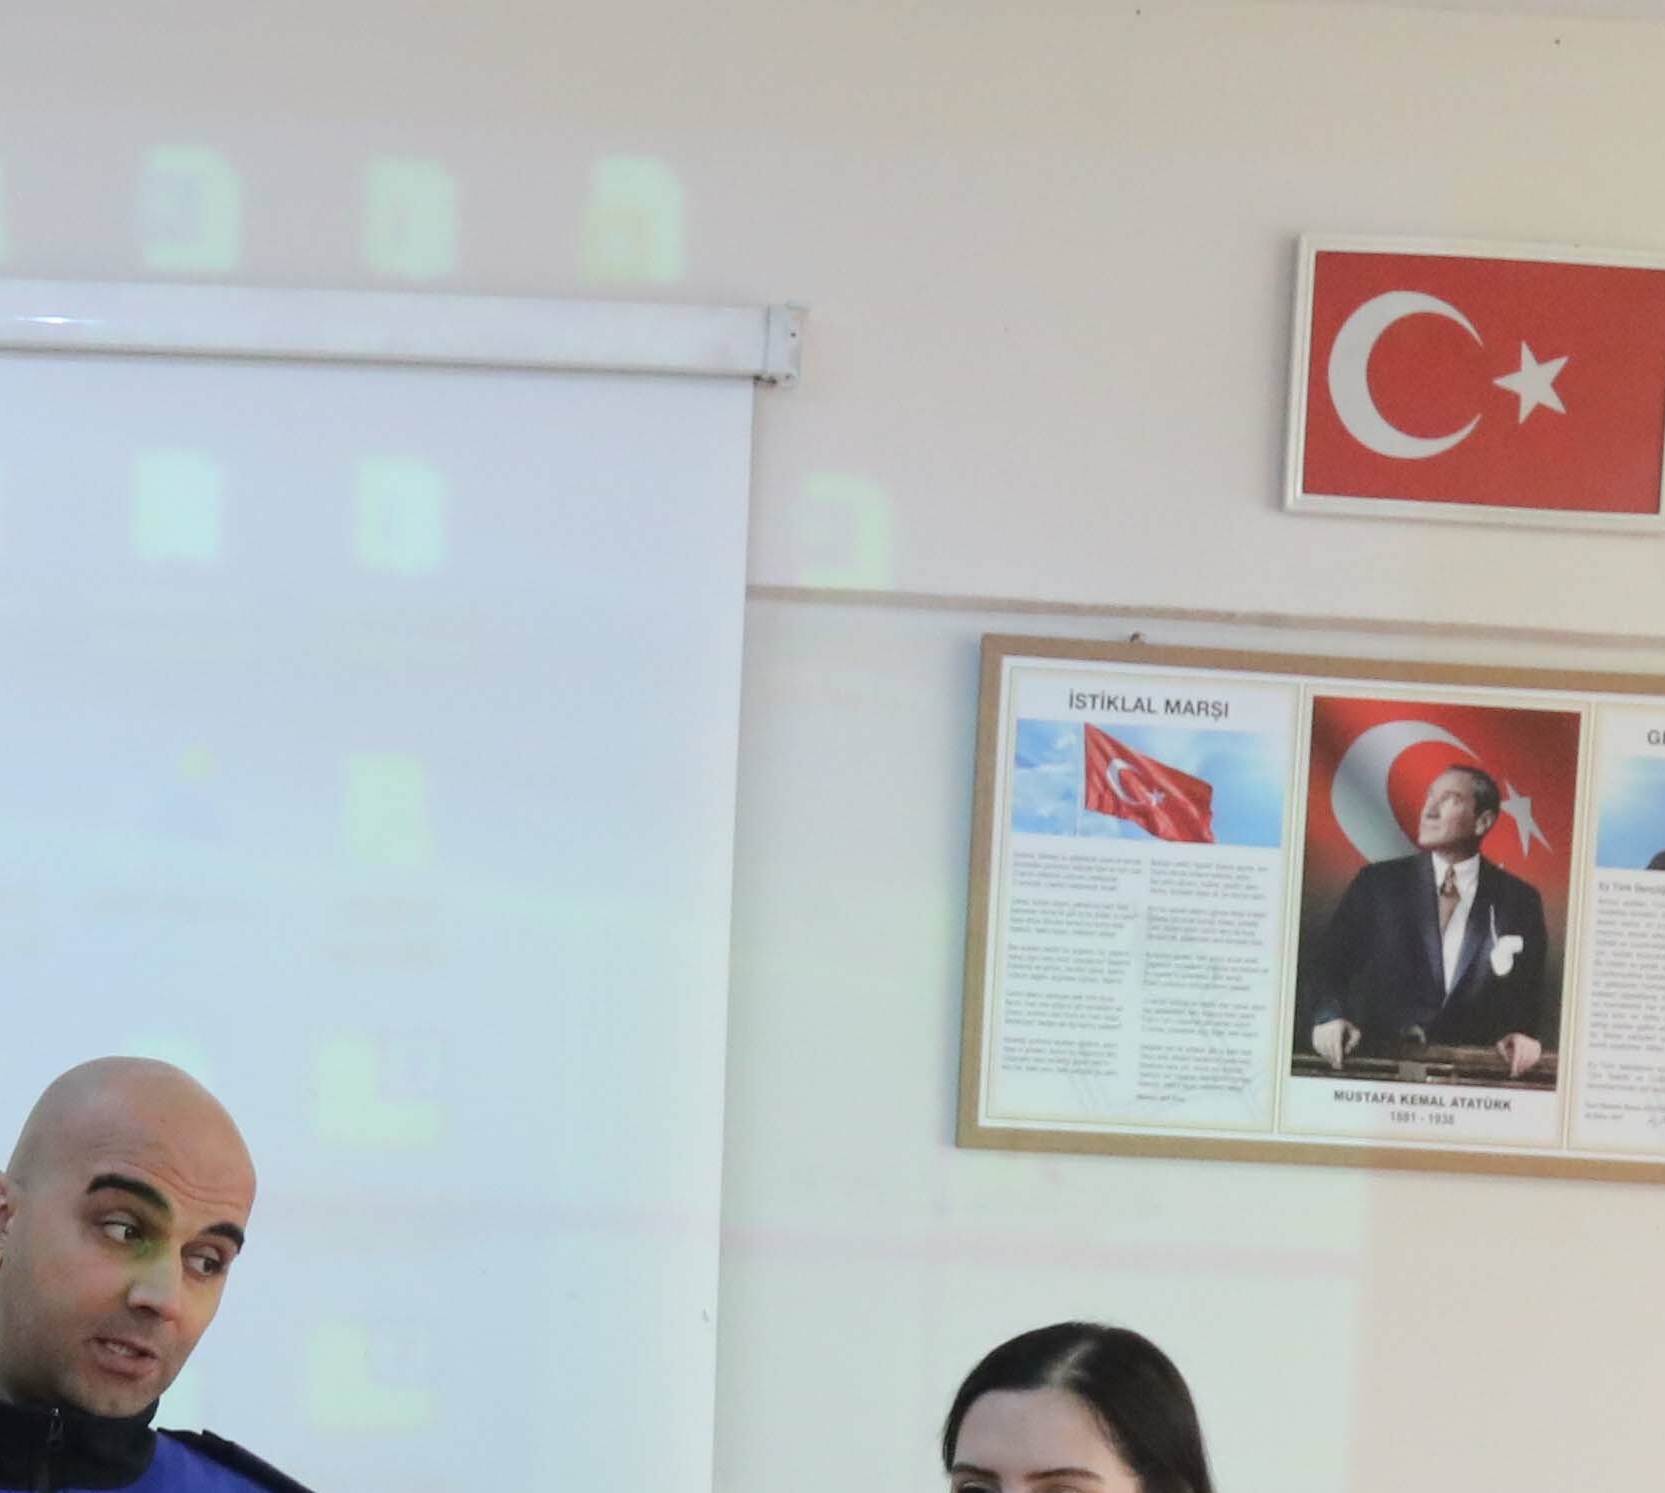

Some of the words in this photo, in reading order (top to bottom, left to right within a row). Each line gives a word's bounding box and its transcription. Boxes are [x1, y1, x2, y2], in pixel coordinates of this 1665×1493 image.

[1069, 689, 1157, 714] İSTİKLAL
[1164, 698, 1229, 721] MARŞI
[1334, 1090, 1396, 1105] MUSTAFA
[1400, 1094, 1446, 1108] KEMAL
[1450, 1096, 1512, 1112] ATATÜRK
